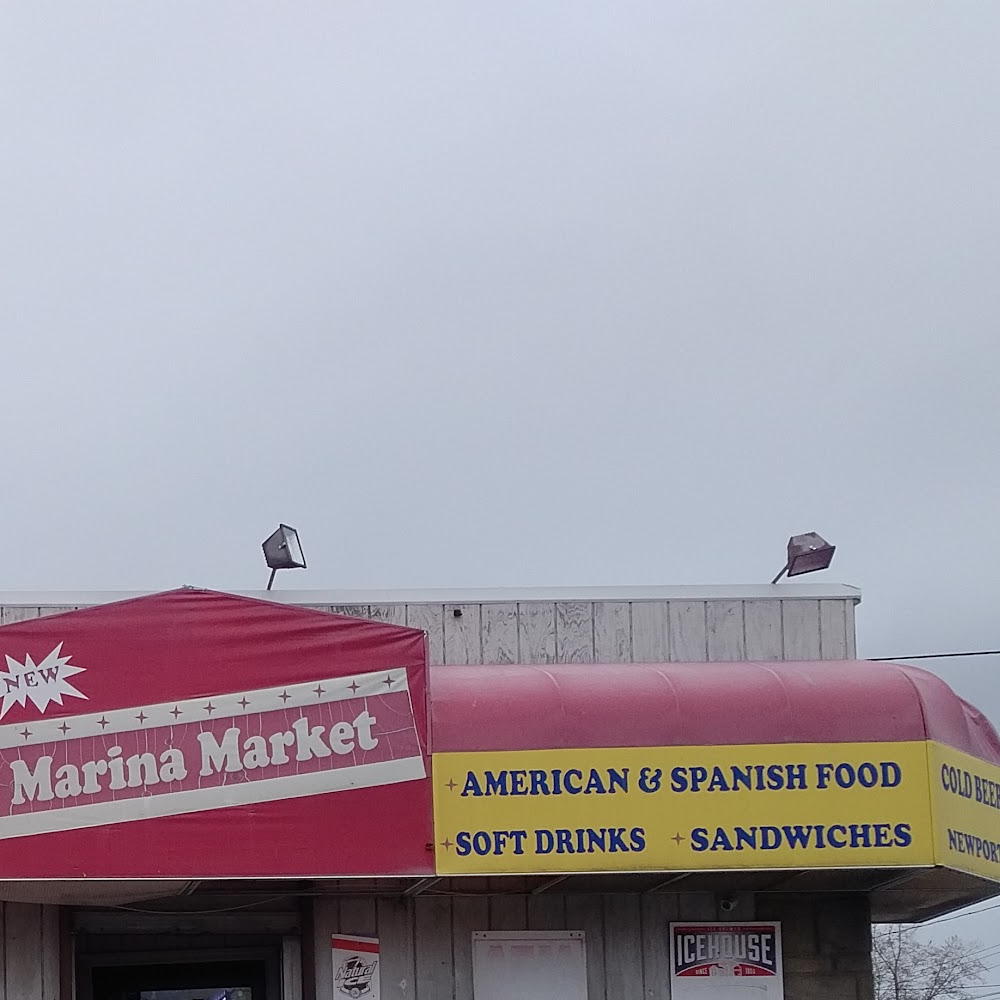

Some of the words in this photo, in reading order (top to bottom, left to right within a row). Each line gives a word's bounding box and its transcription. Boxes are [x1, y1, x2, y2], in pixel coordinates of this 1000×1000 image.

[3, 665, 60, 694] NEW
[10, 745, 188, 805] Marina
[199, 710, 379, 777] Market
[461, 768, 629, 797] AMERICAN
[638, 767, 662, 793] &
[671, 763, 807, 793] SPANISH
[816, 761, 902, 789] FOOD
[941, 763, 973, 799] COLD
[456, 830, 527, 856] SOFT
[535, 827, 646, 854] DRINKS
[691, 823, 912, 852] SANDWICHES
[677, 934, 773, 967] ICEHOUSE
[334, 961, 378, 981] Natural
